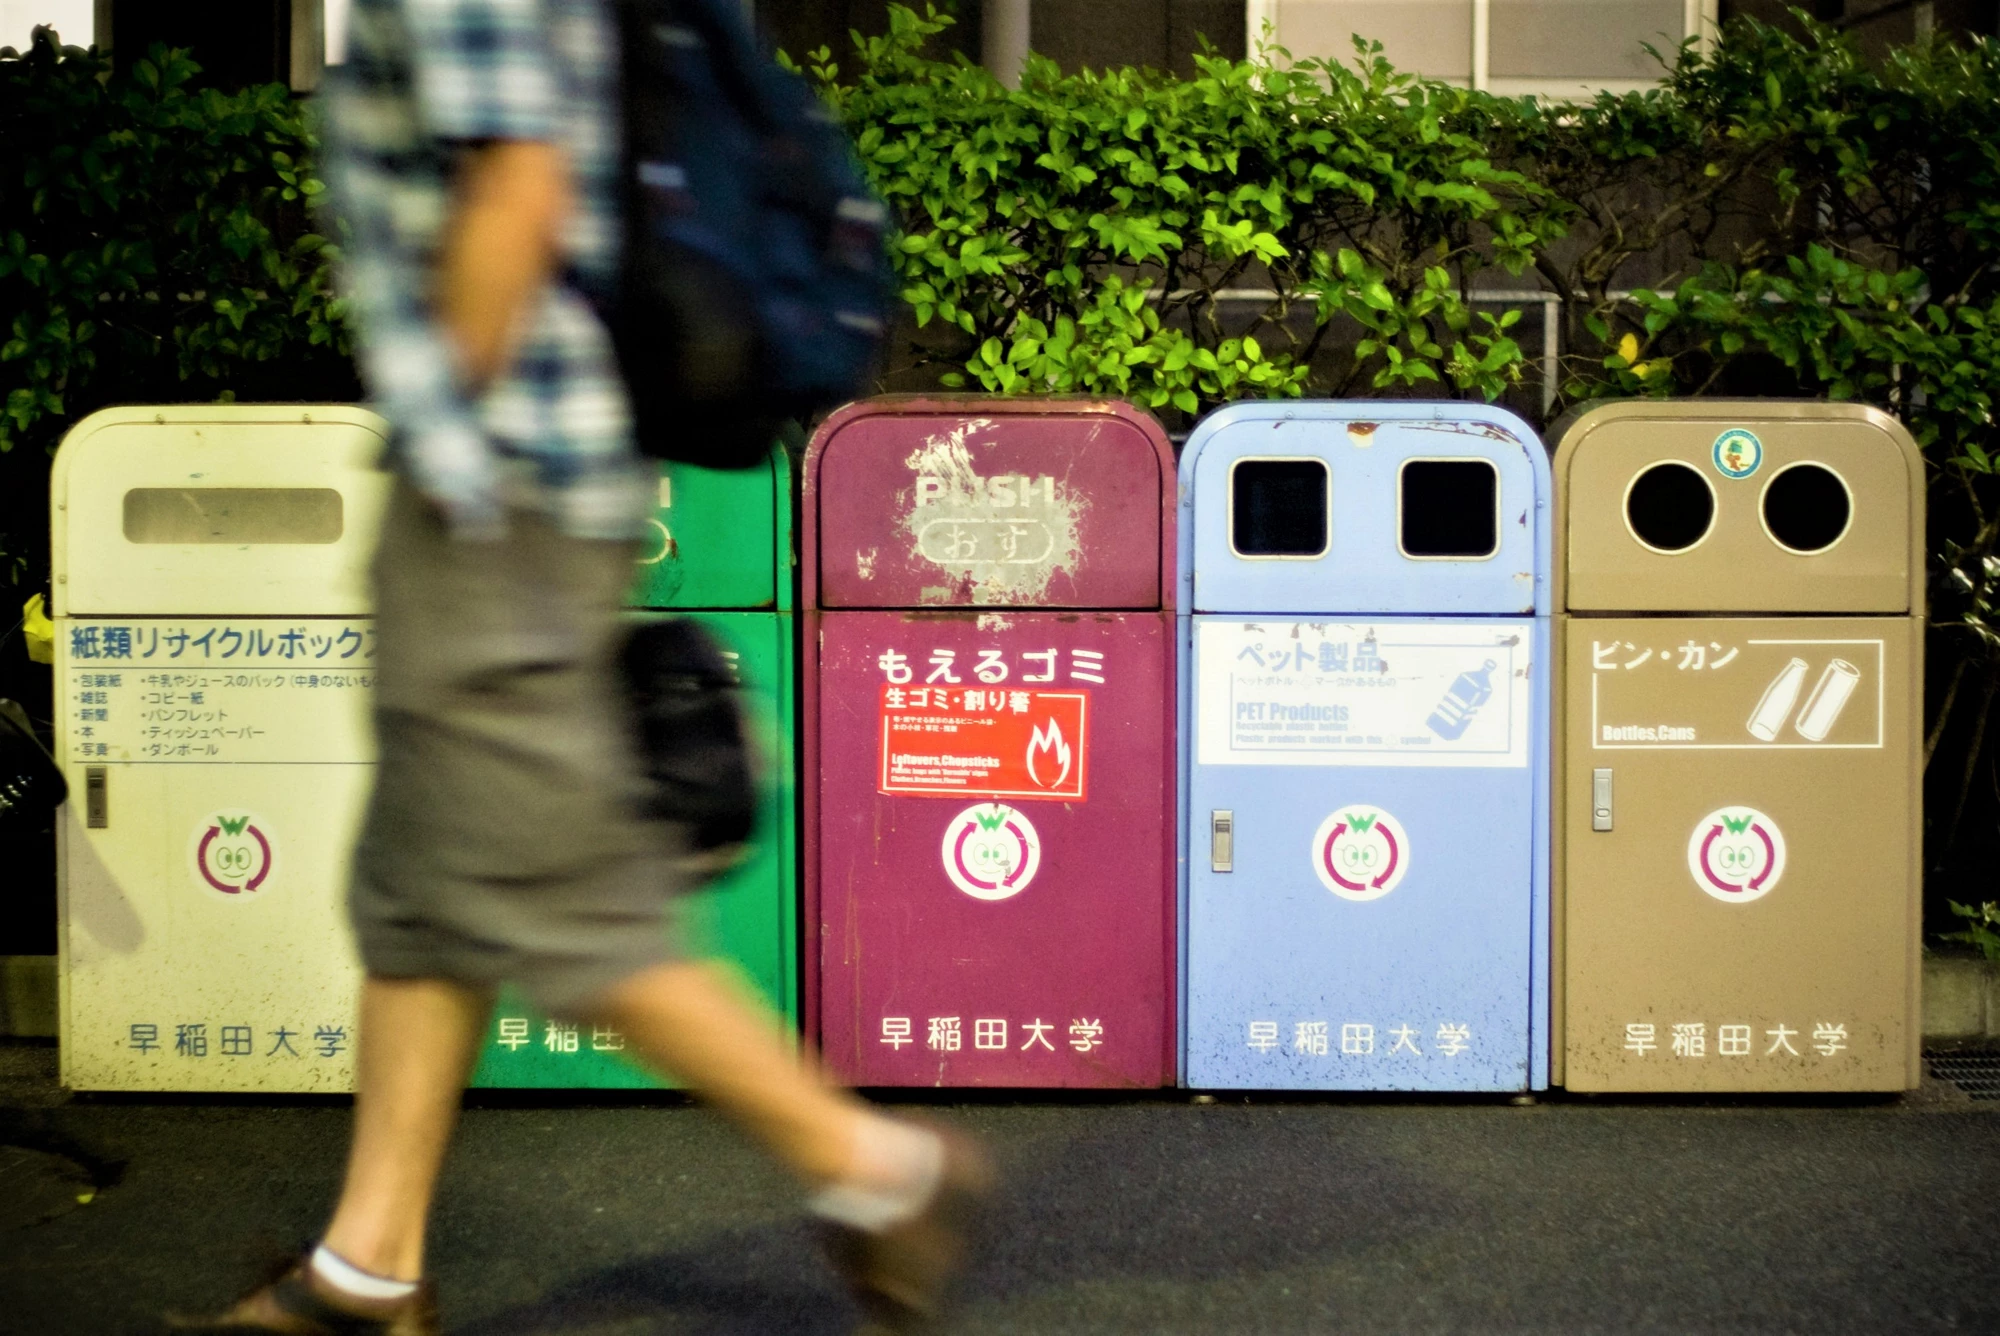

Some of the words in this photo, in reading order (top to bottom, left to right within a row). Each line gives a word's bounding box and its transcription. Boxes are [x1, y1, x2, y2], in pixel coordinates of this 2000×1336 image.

[878, 648, 1105, 684] もえるゴミ
[1237, 642, 1383, 672] ペット製品
[1592, 640, 1740, 670] ビン・カン
[885, 687, 1030, 715] 生ゴミ・割り箸
[1236, 702, 1266, 720] PET
[1270, 702, 1349, 721] Products
[1602, 725, 1696, 741] Bottles,Cans
[128, 1024, 347, 1057] 早稲田大学
[880, 1016, 1103, 1051] 早稲田大学
[1247, 1021, 1470, 1056] 早稲田大学
[1624, 1022, 1848, 1056] 早稲田大学
